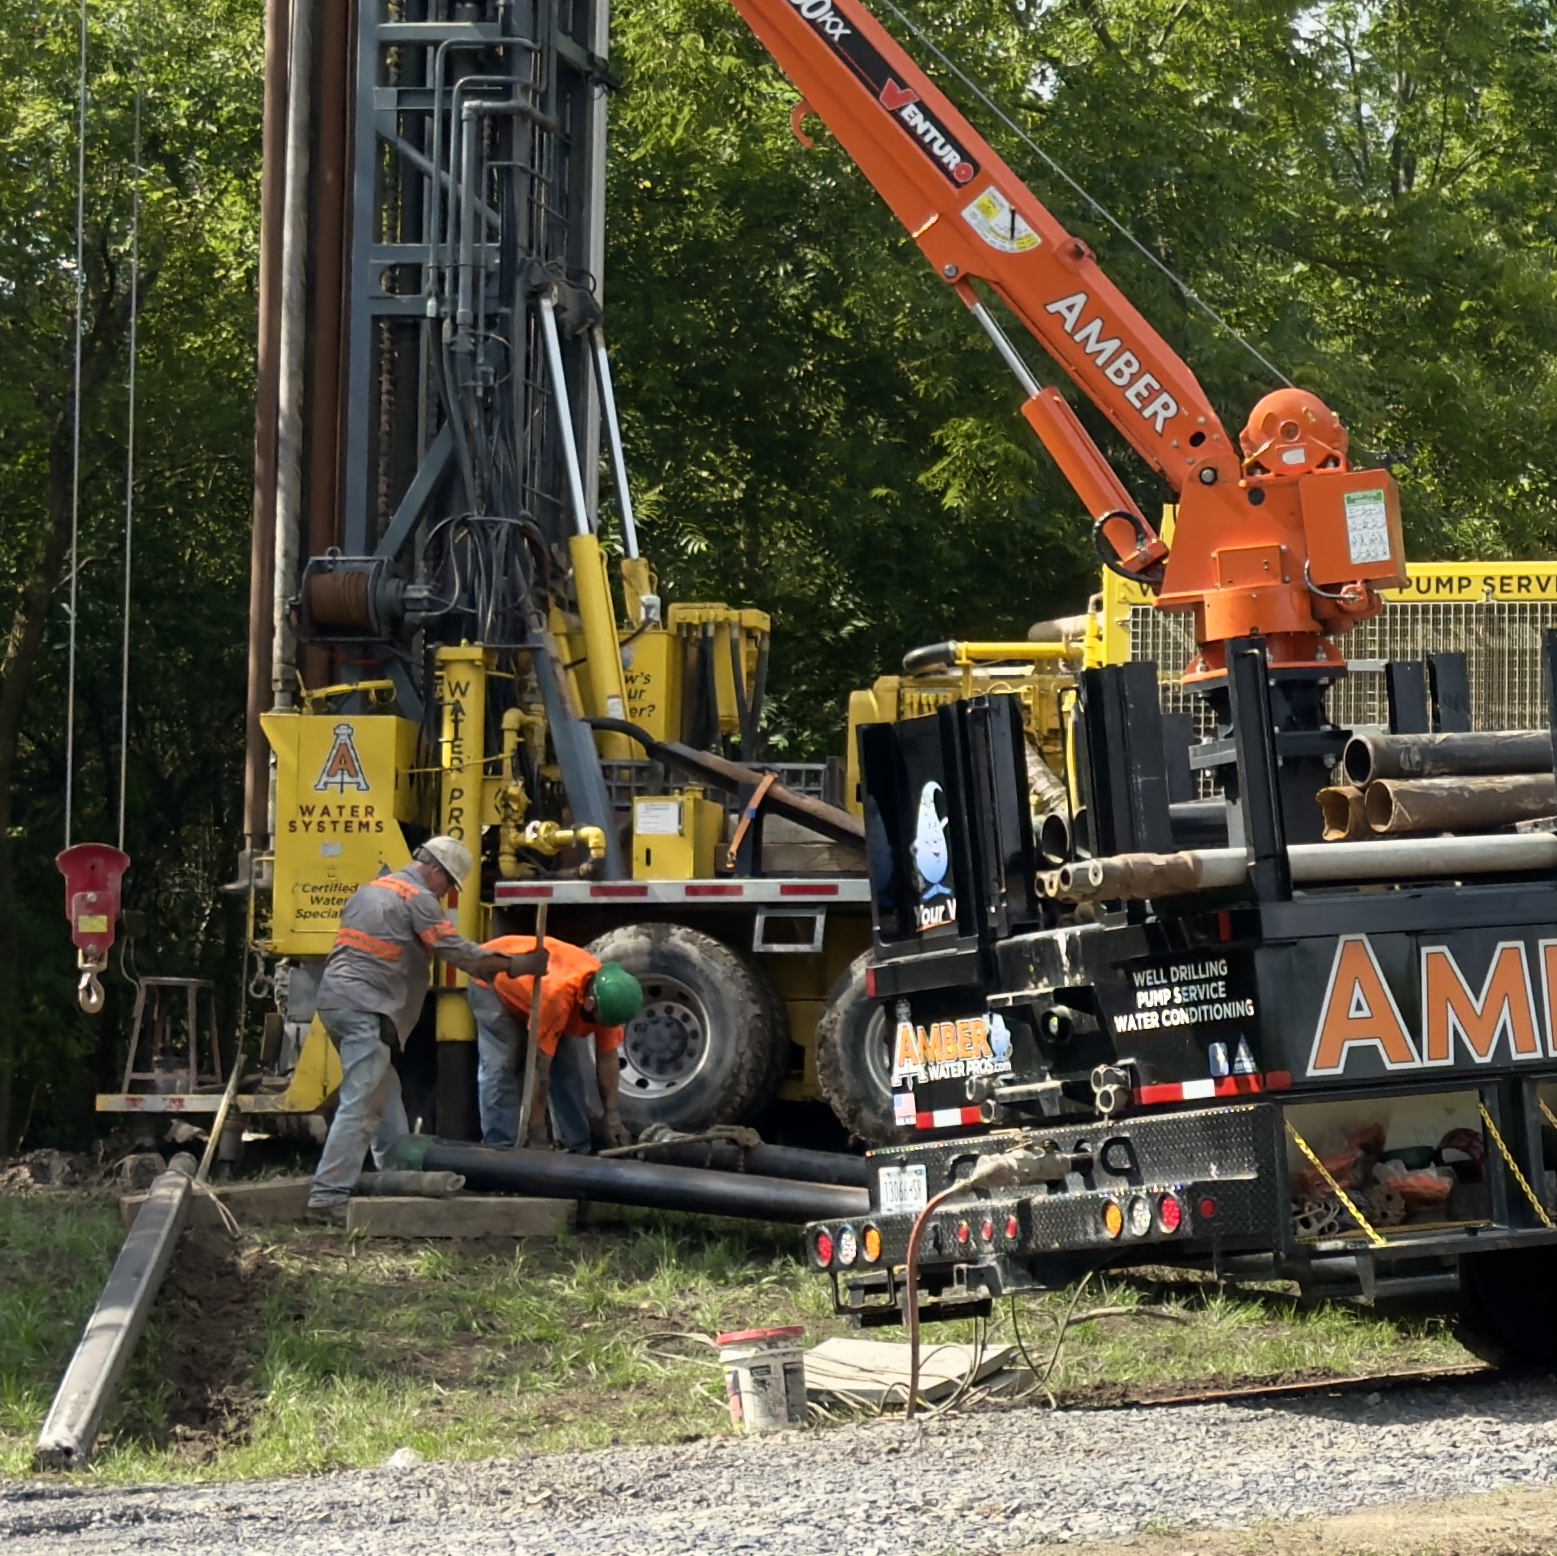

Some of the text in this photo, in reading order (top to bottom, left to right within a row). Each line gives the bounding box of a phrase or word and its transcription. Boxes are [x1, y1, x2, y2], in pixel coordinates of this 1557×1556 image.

[879, 77, 974, 183] VENTURO
[1045, 291, 1178, 435] AMBER
[1398, 575, 1473, 595] PUMP
[625, 672, 651, 685] w's
[628, 687, 646, 700] ur
[629, 704, 656, 719] er?
[299, 804, 376, 818] WATER
[447, 788, 465, 842] PRO
[288, 820, 385, 833] SYSTEMS
[301, 882, 359, 894] Certified
[296, 908, 342, 920] Special
[1133, 959, 1228, 987] WELL DRILLING
[1136, 980, 1227, 1009] PUMP SERVICE
[1114, 998, 1255, 1033] WATER CONDITIONING
[898, 1017, 993, 1068] AMBER
[928, 1061, 965, 1081] WATER
